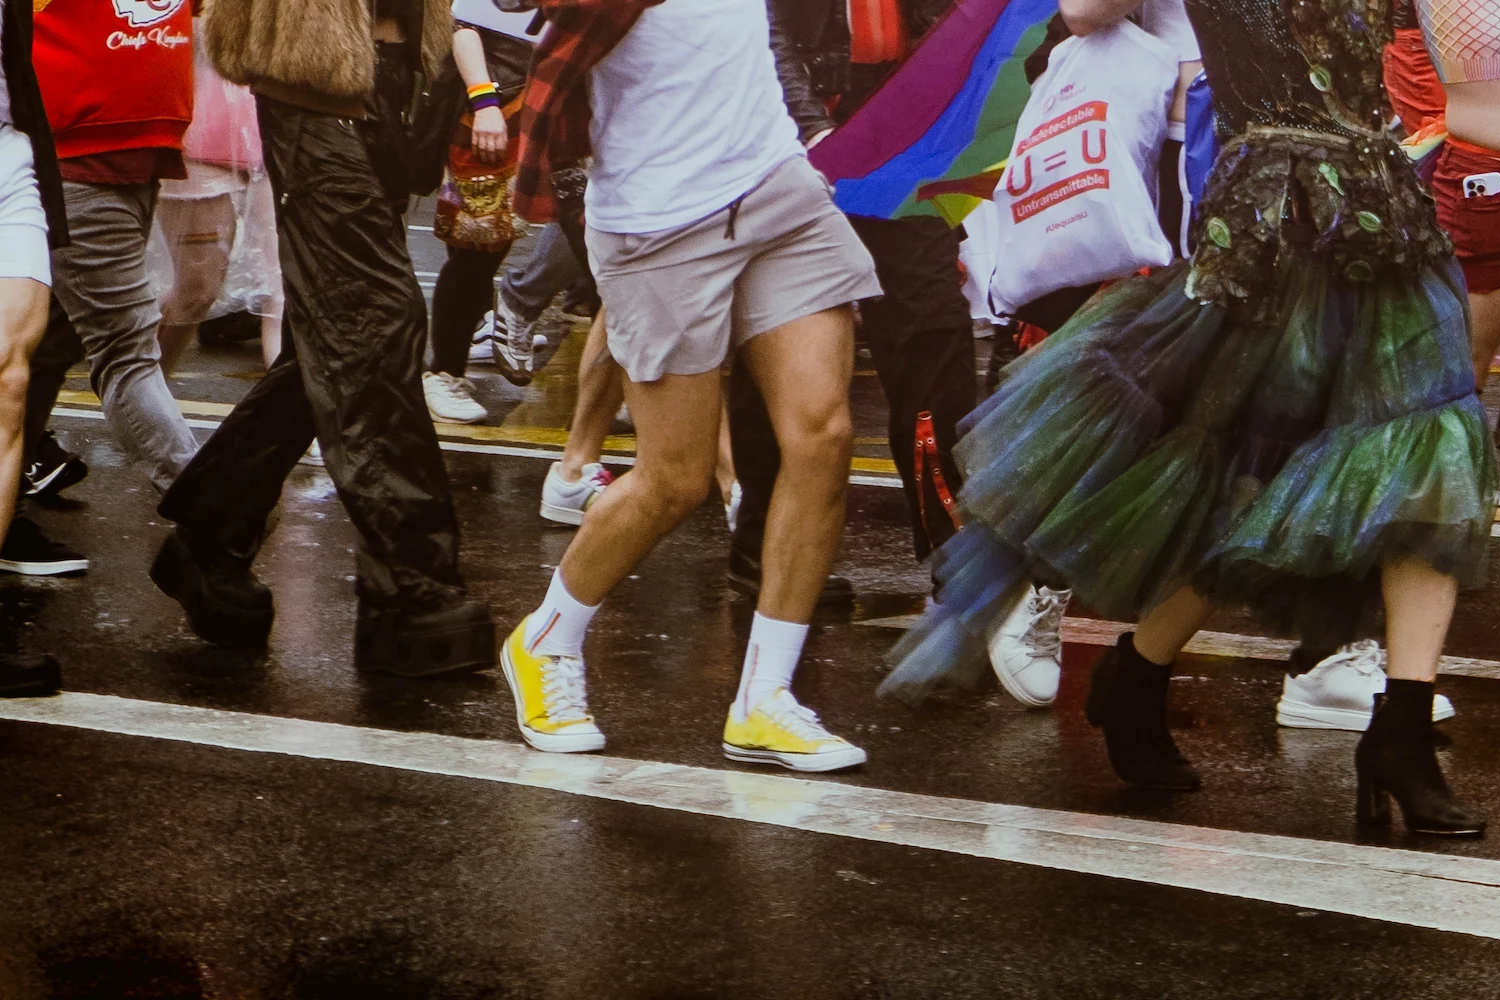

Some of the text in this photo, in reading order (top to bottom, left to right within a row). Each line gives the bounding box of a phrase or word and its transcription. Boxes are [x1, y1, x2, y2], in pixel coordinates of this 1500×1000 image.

[1006, 155, 1032, 197] U
[1082, 128, 1106, 164] U
[1017, 173, 1105, 217] Untransmittable
